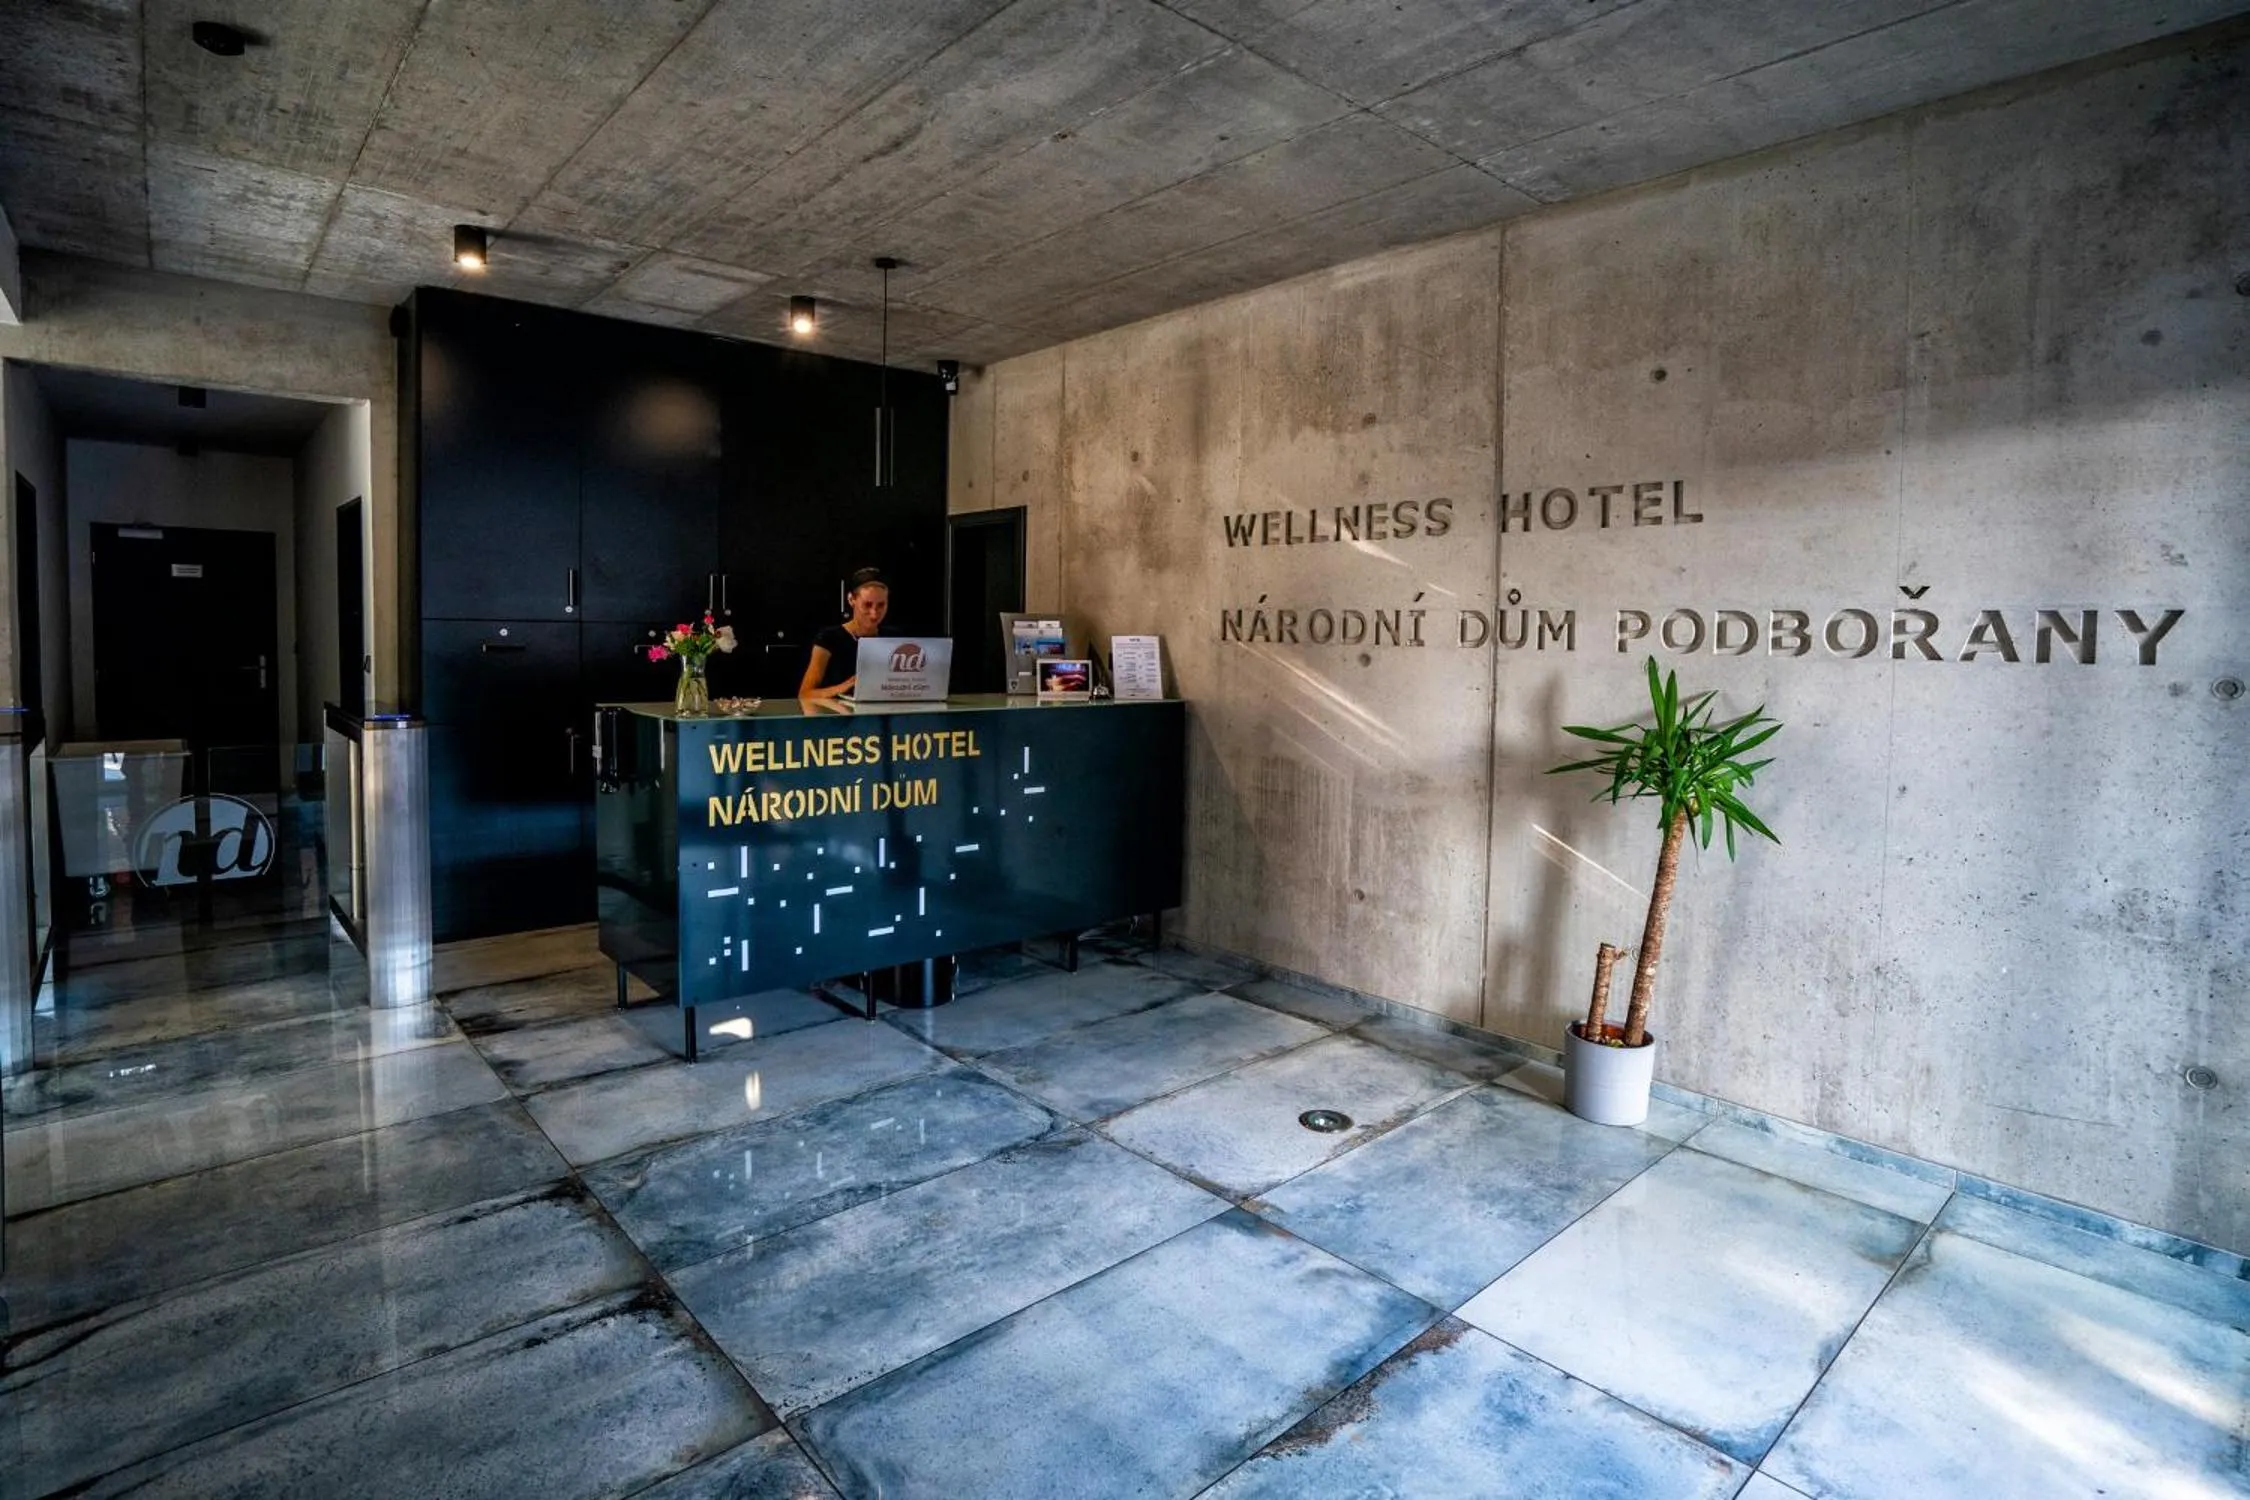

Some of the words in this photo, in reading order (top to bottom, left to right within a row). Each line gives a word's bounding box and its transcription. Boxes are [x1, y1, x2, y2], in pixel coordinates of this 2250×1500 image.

[1222, 497, 1454, 548] WELLNESS
[1500, 479, 1704, 534] HOTEL
[1219, 592, 1427, 649] NÁRODNÍ
[1457, 588, 1577, 652] DŮM
[1616, 584, 2186, 667] PODBOŘANY
[708, 735, 882, 775] WELLNESS
[891, 730, 981, 763] HOTEL
[708, 777, 864, 827] NÁRODNÍ
